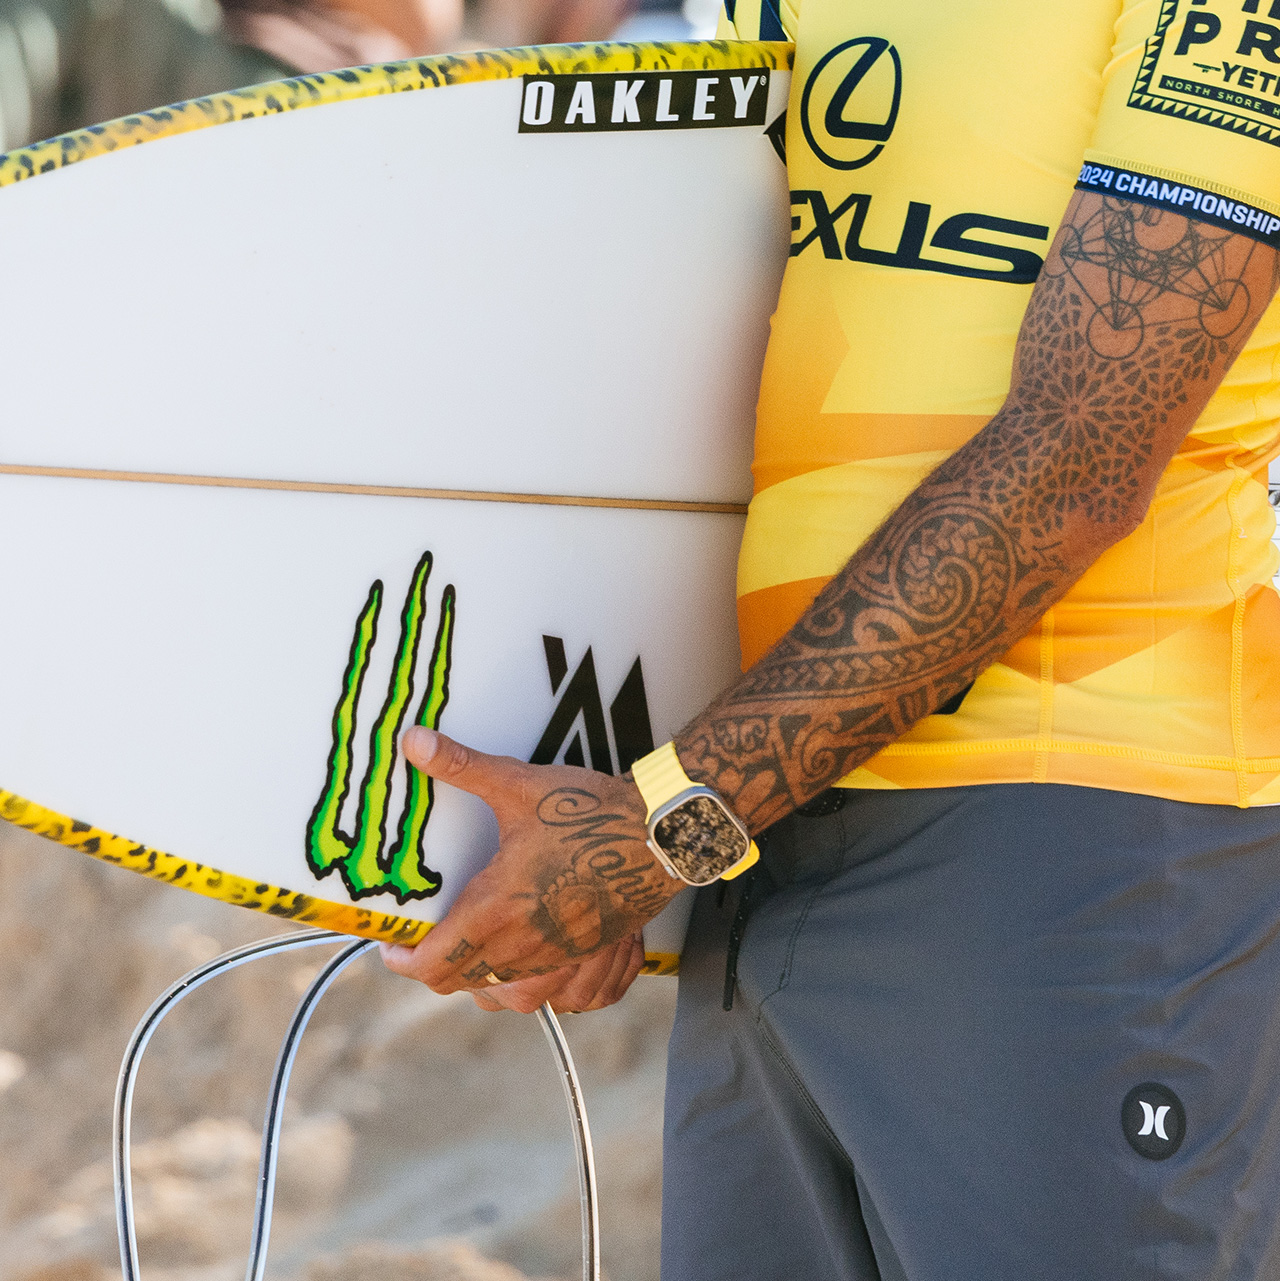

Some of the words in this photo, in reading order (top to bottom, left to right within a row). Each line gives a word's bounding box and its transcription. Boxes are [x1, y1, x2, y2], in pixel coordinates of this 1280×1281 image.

[1166, 79, 1210, 96] NORTH
[1078, 164, 1114, 188] 2024
[1115, 173, 1280, 235] CHAMPIONSHIP
